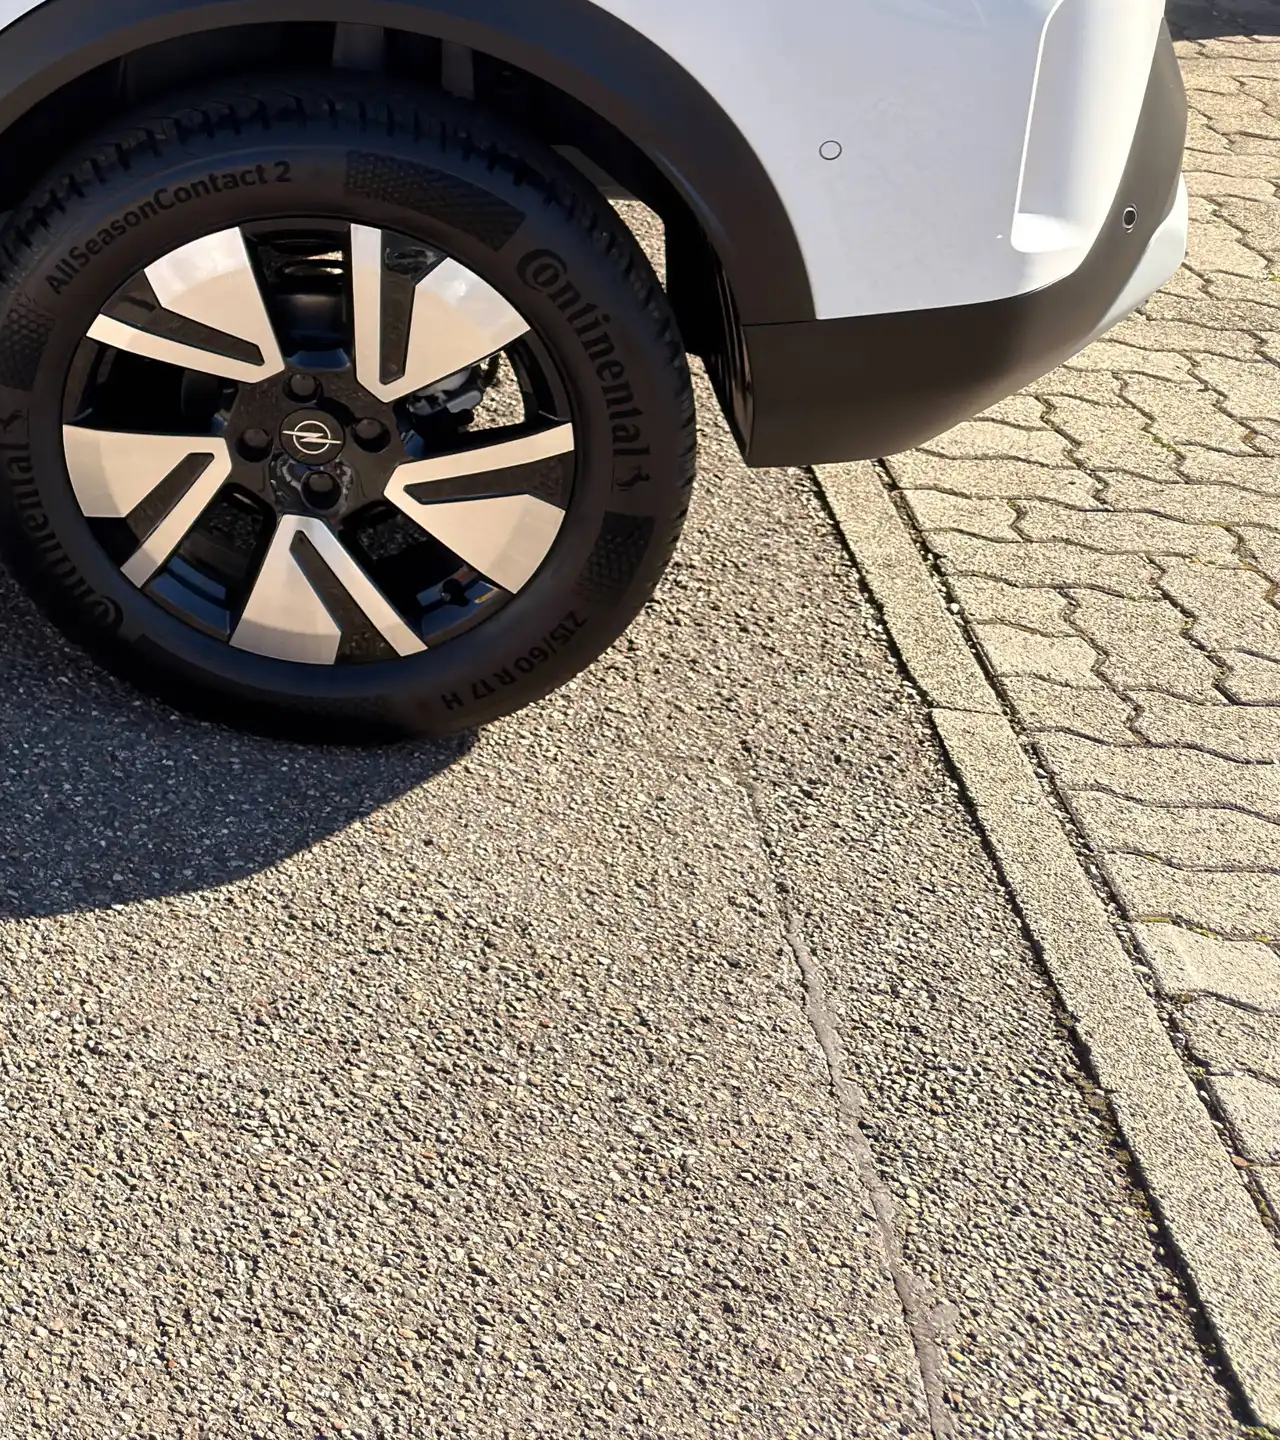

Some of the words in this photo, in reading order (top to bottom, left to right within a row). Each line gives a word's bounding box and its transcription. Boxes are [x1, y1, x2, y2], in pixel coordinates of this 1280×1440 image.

[45, 163, 269, 295] AllSeasonContact
[274, 160, 293, 183] 2
[515, 248, 652, 459] Continental
[514, 609, 589, 675] 215/60
[470, 679, 496, 702] 17
[492, 665, 518, 687] R
[440, 690, 465, 712] H
